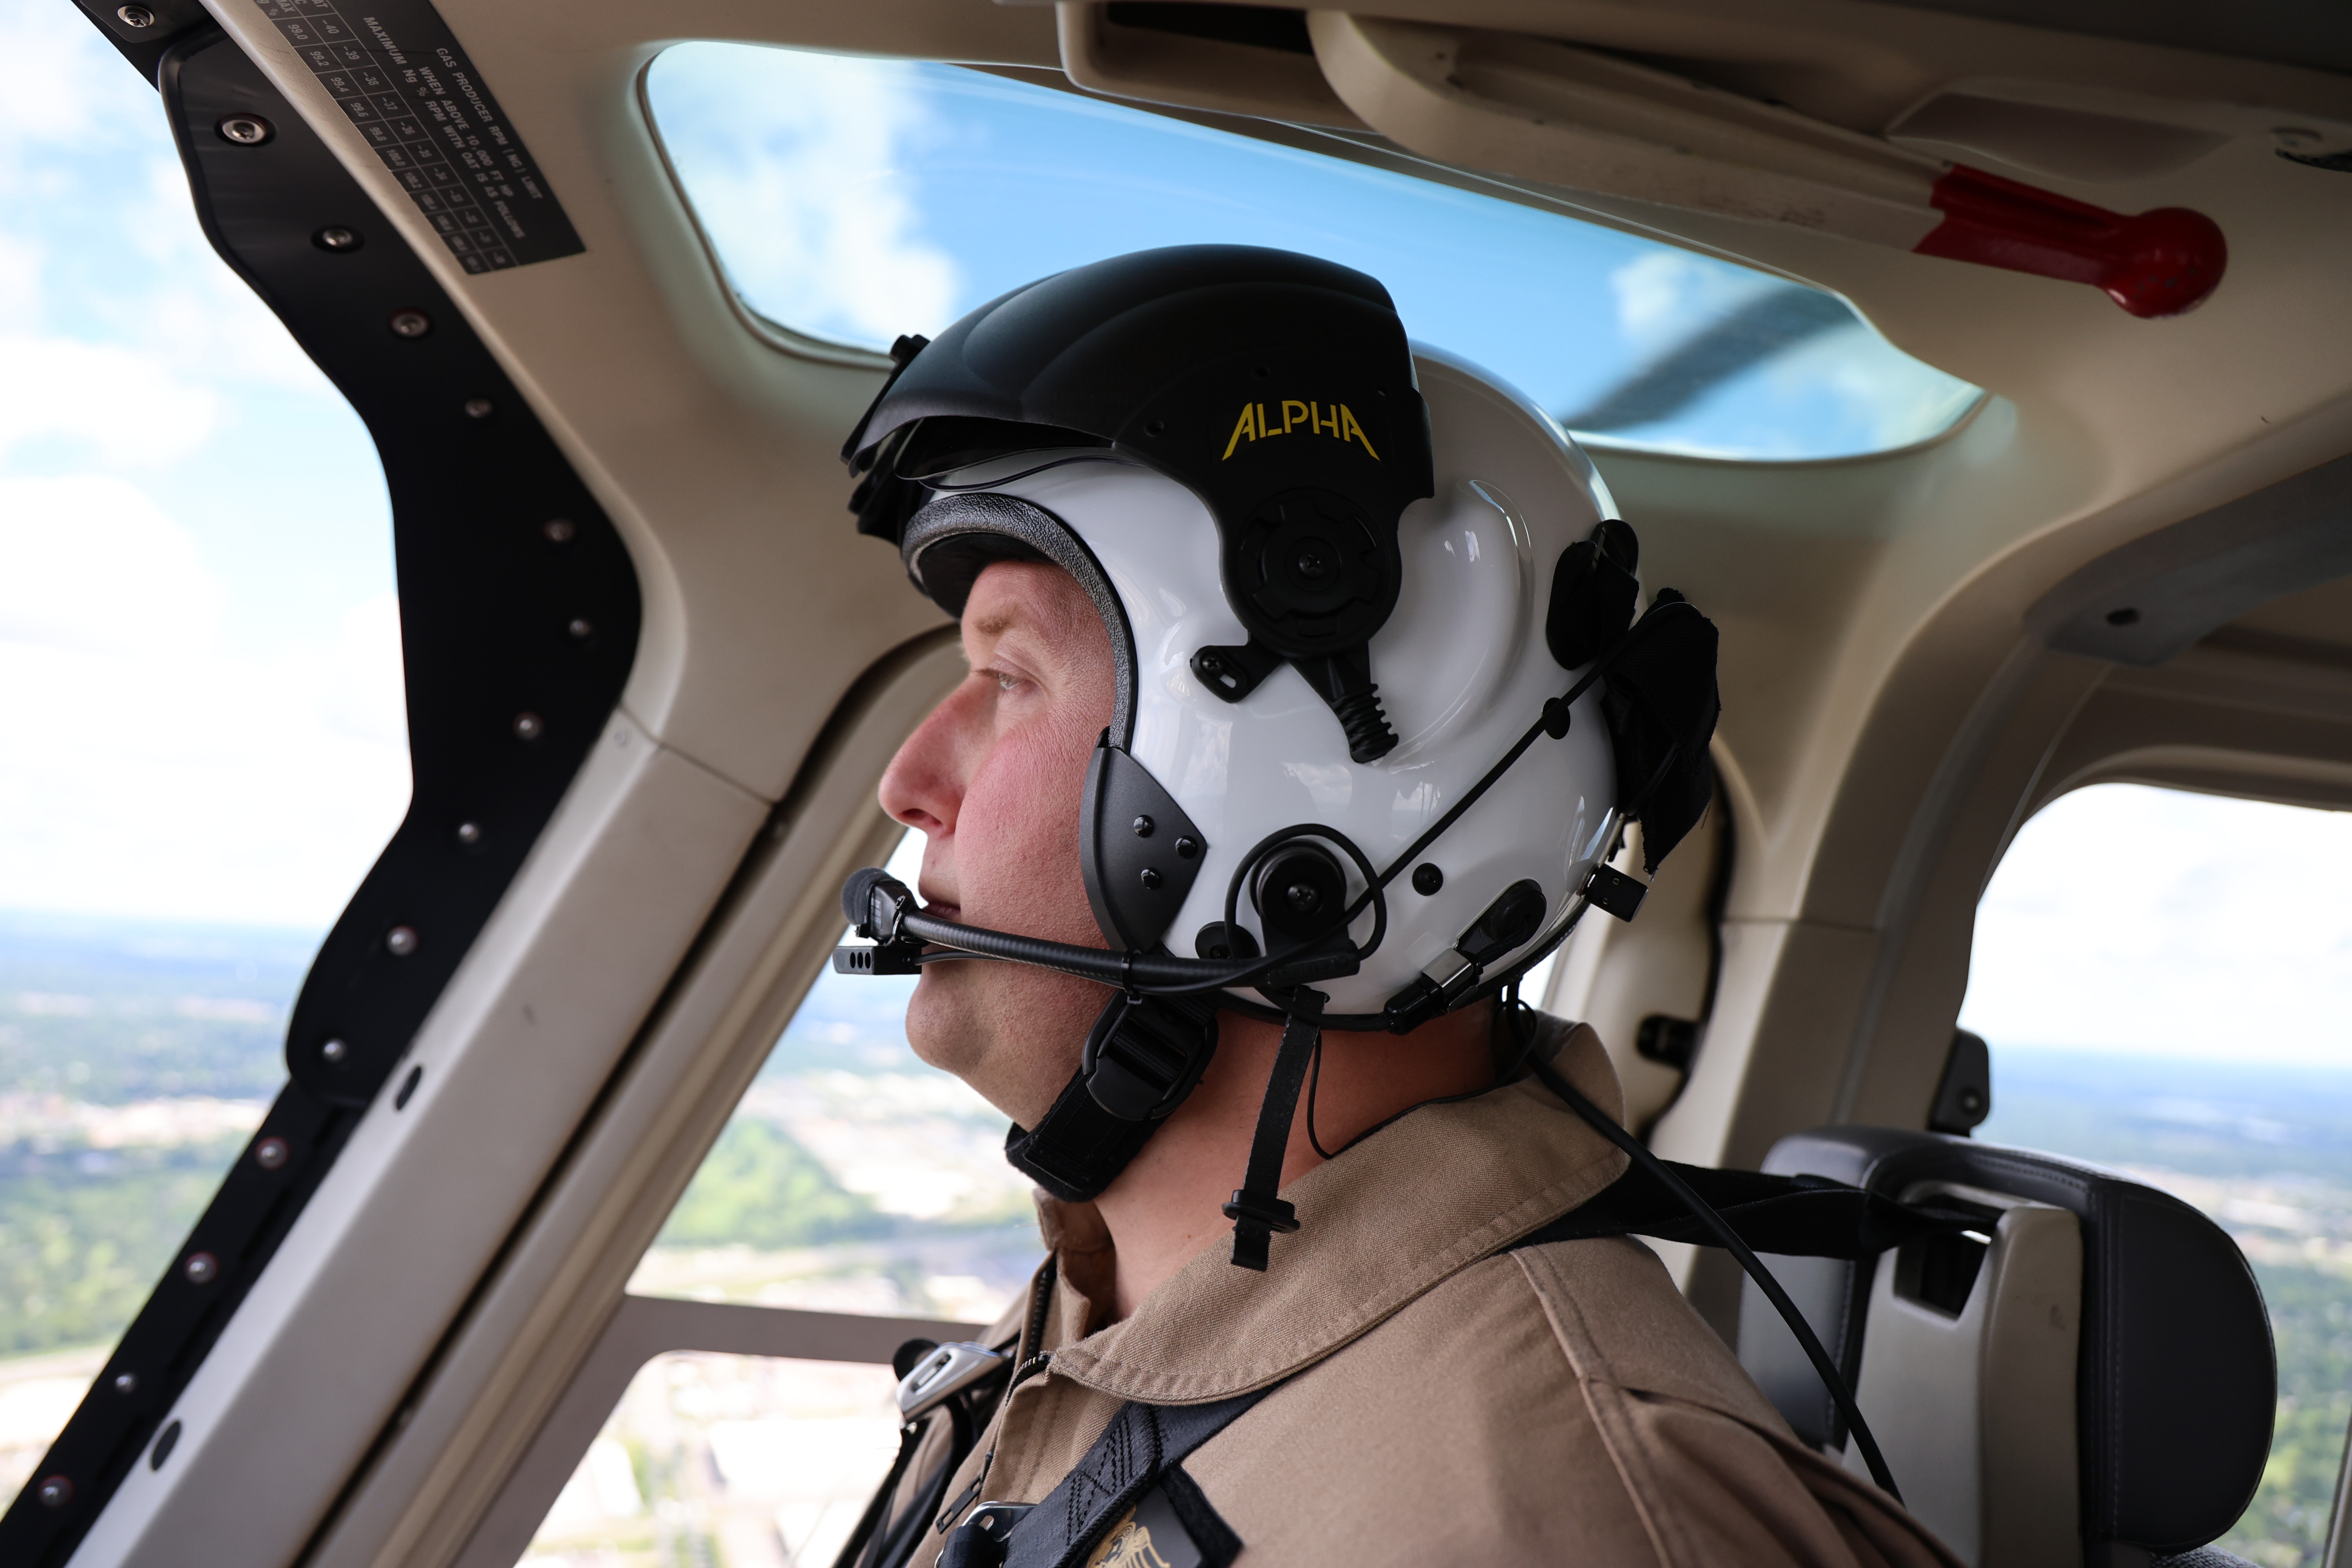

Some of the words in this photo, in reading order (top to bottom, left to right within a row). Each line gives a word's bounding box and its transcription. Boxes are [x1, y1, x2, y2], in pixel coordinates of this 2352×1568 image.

[288, 25, 308, 39] 99.0
[310, 51, 329, 66] 99.2
[330, 78, 349, 92] 99.4
[351, 103, 368, 116] 99.6
[369, 127, 387, 141] 99.8
[323, 20, 339, 33] -40
[343, 46, 359, 59] -39
[363, 72, 379, 85] -38
[383, 97, 397, 109] -37
[401, 122, 415, 134] -36
[418, 145, 432, 158] -35
[363, 17, 407, 64] MAXIMUM
[403, 69, 417, 82] Ng
[416, 87, 428, 96] %
[425, 101, 447, 121] RPM
[443, 125, 465, 148] WITH
[462, 152, 480, 168] OAT
[475, 173, 488, 182] IS
[484, 187, 498, 197] AS
[494, 201, 524, 238] FOLLOWS
[419, 67, 445, 94] WHEN
[441, 100, 469, 129] ABOVE
[466, 135, 493, 166] 10,000
[490, 171, 503, 180] FT
[436, 48, 456, 67] GAS
[452, 73, 492, 122] PRODUCER
[489, 126, 508, 145] RPM
[521, 176, 542, 198] LIMIT
[1222, 400, 1381, 461] ALPHA
